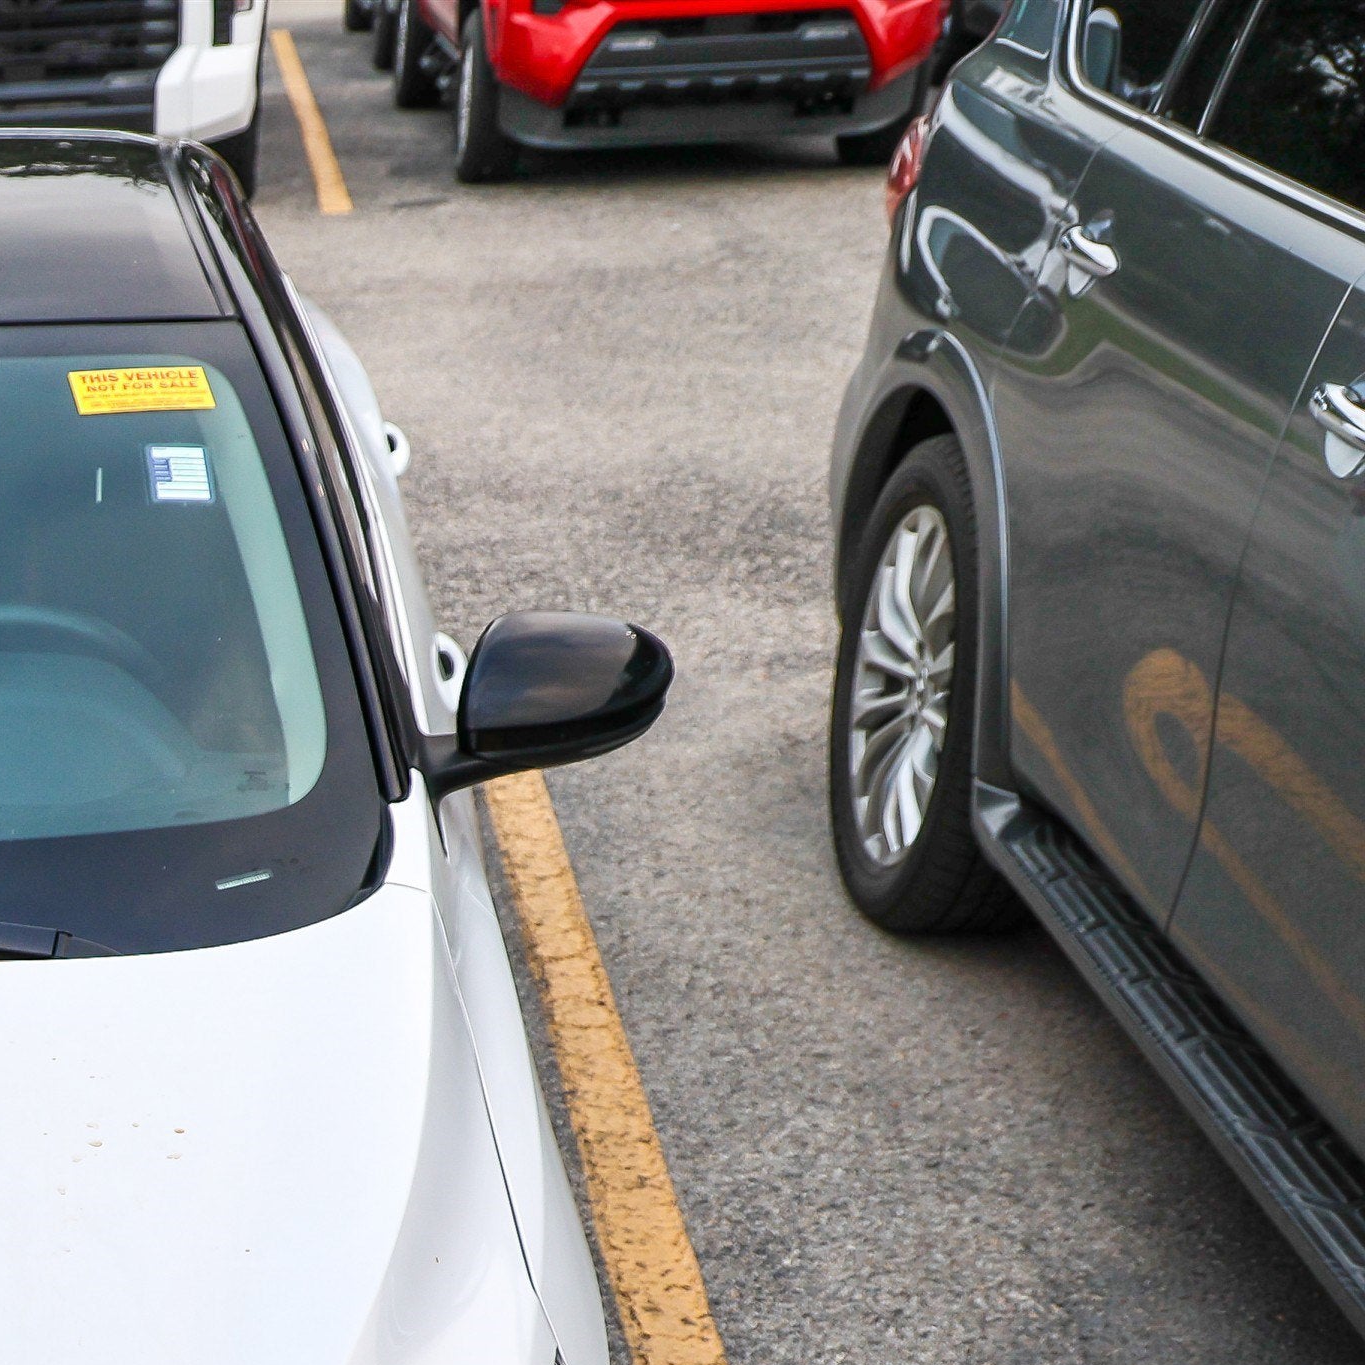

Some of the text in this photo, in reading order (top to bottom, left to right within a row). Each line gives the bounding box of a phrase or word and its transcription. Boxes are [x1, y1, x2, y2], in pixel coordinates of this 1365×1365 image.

[79, 369, 199, 384] THIS VEHICLE
[86, 380, 199, 392] NOT FOR SALE
